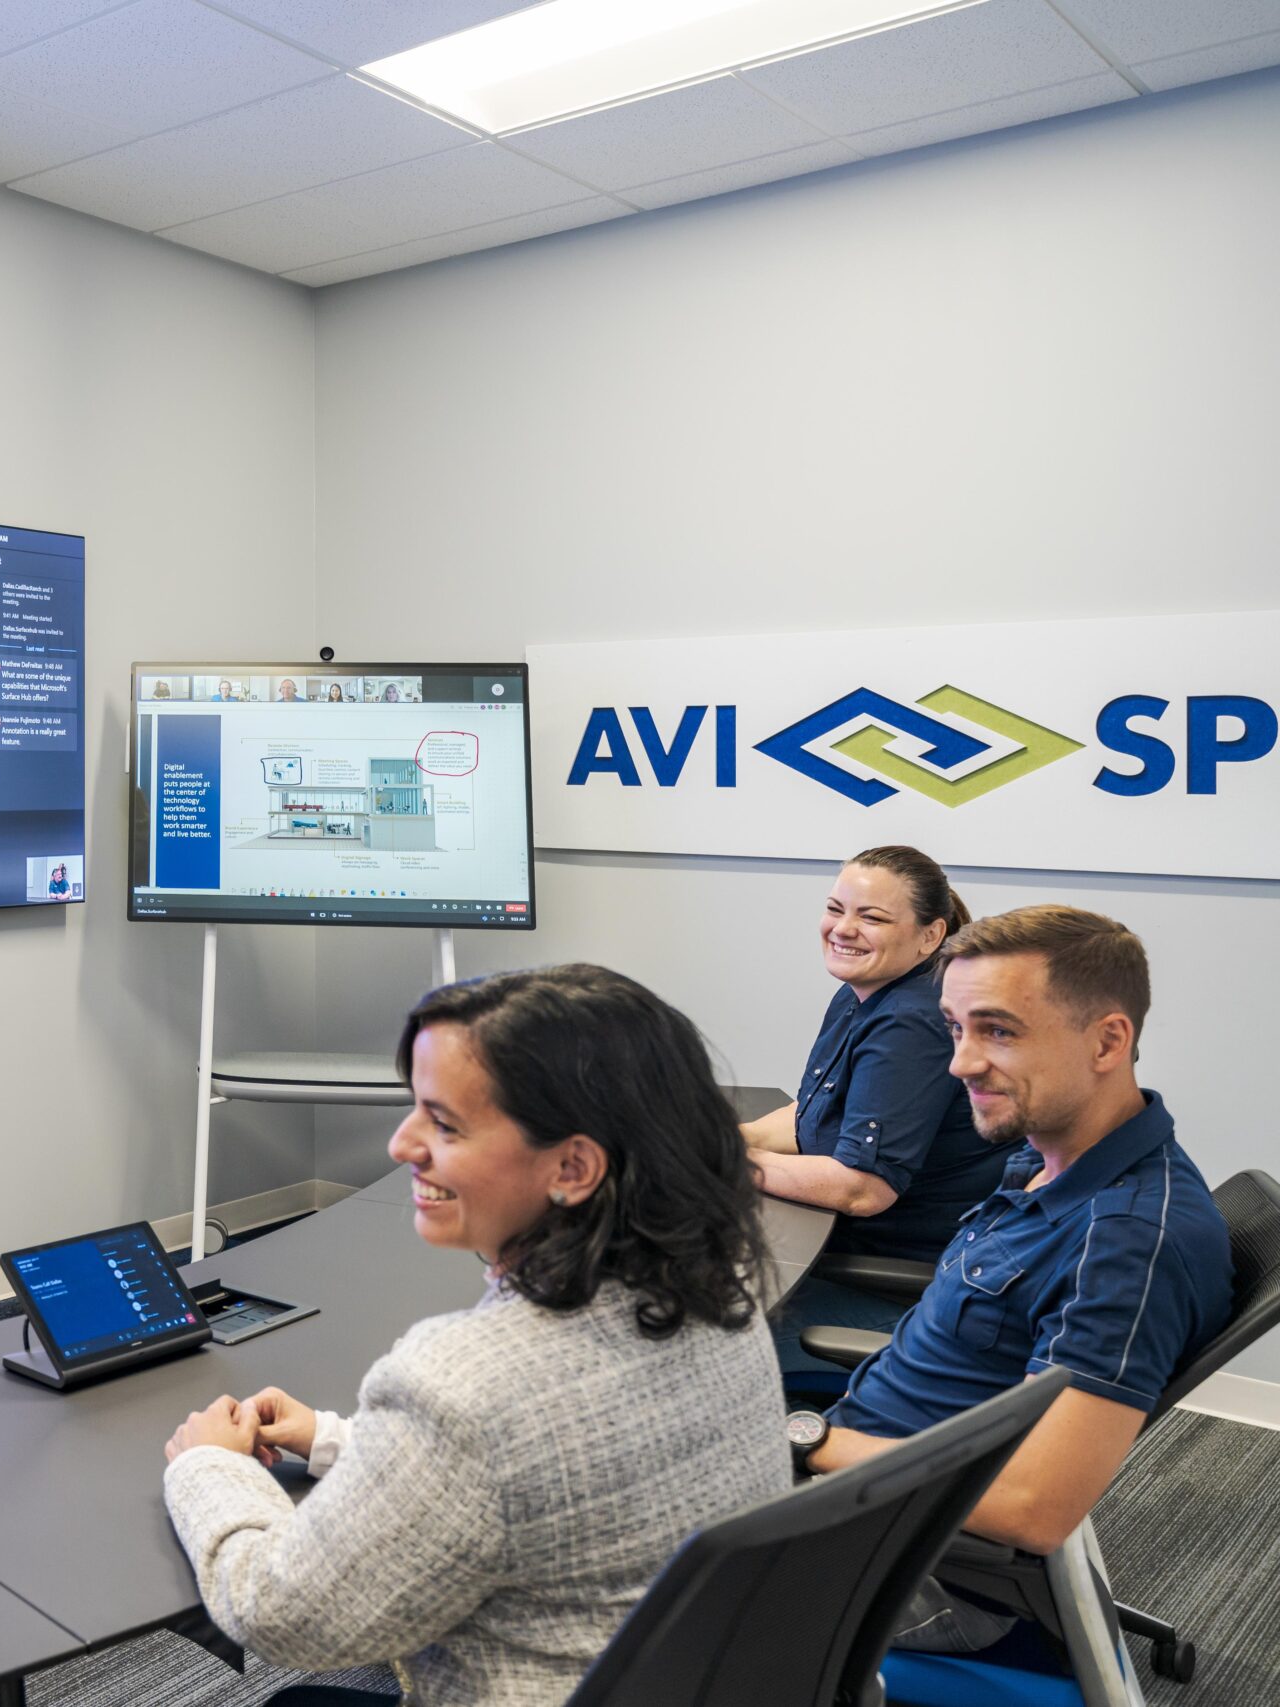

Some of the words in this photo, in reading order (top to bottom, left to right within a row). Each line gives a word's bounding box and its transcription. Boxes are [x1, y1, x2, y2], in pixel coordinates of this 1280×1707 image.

[22, 614, 38, 622] Meeting
[46, 628, 59, 636] invited
[1, 660, 21, 668] Mathew
[1, 671, 15, 679] What
[54, 675, 71, 683] unique
[1, 681, 29, 691] capabilities
[40, 684, 67, 692] Microsoft's
[1, 692, 20, 700] Surface
[20, 693, 31, 701] Hub
[32, 694, 49, 702] offers?
[20, 716, 41, 725] Fujimoto
[1, 727, 29, 735] Annotation
[39, 728, 53, 737] really
[53, 729, 66, 737] great
[1, 737, 20, 745] feature.
[566, 704, 736, 788] AVI
[1092, 694, 1278, 796] SP
[164, 763, 185, 771] Digital
[163, 797, 200, 805] technology
[163, 805, 197, 813] workflows
[163, 814, 178, 822] help
[176, 830, 189, 838] live
